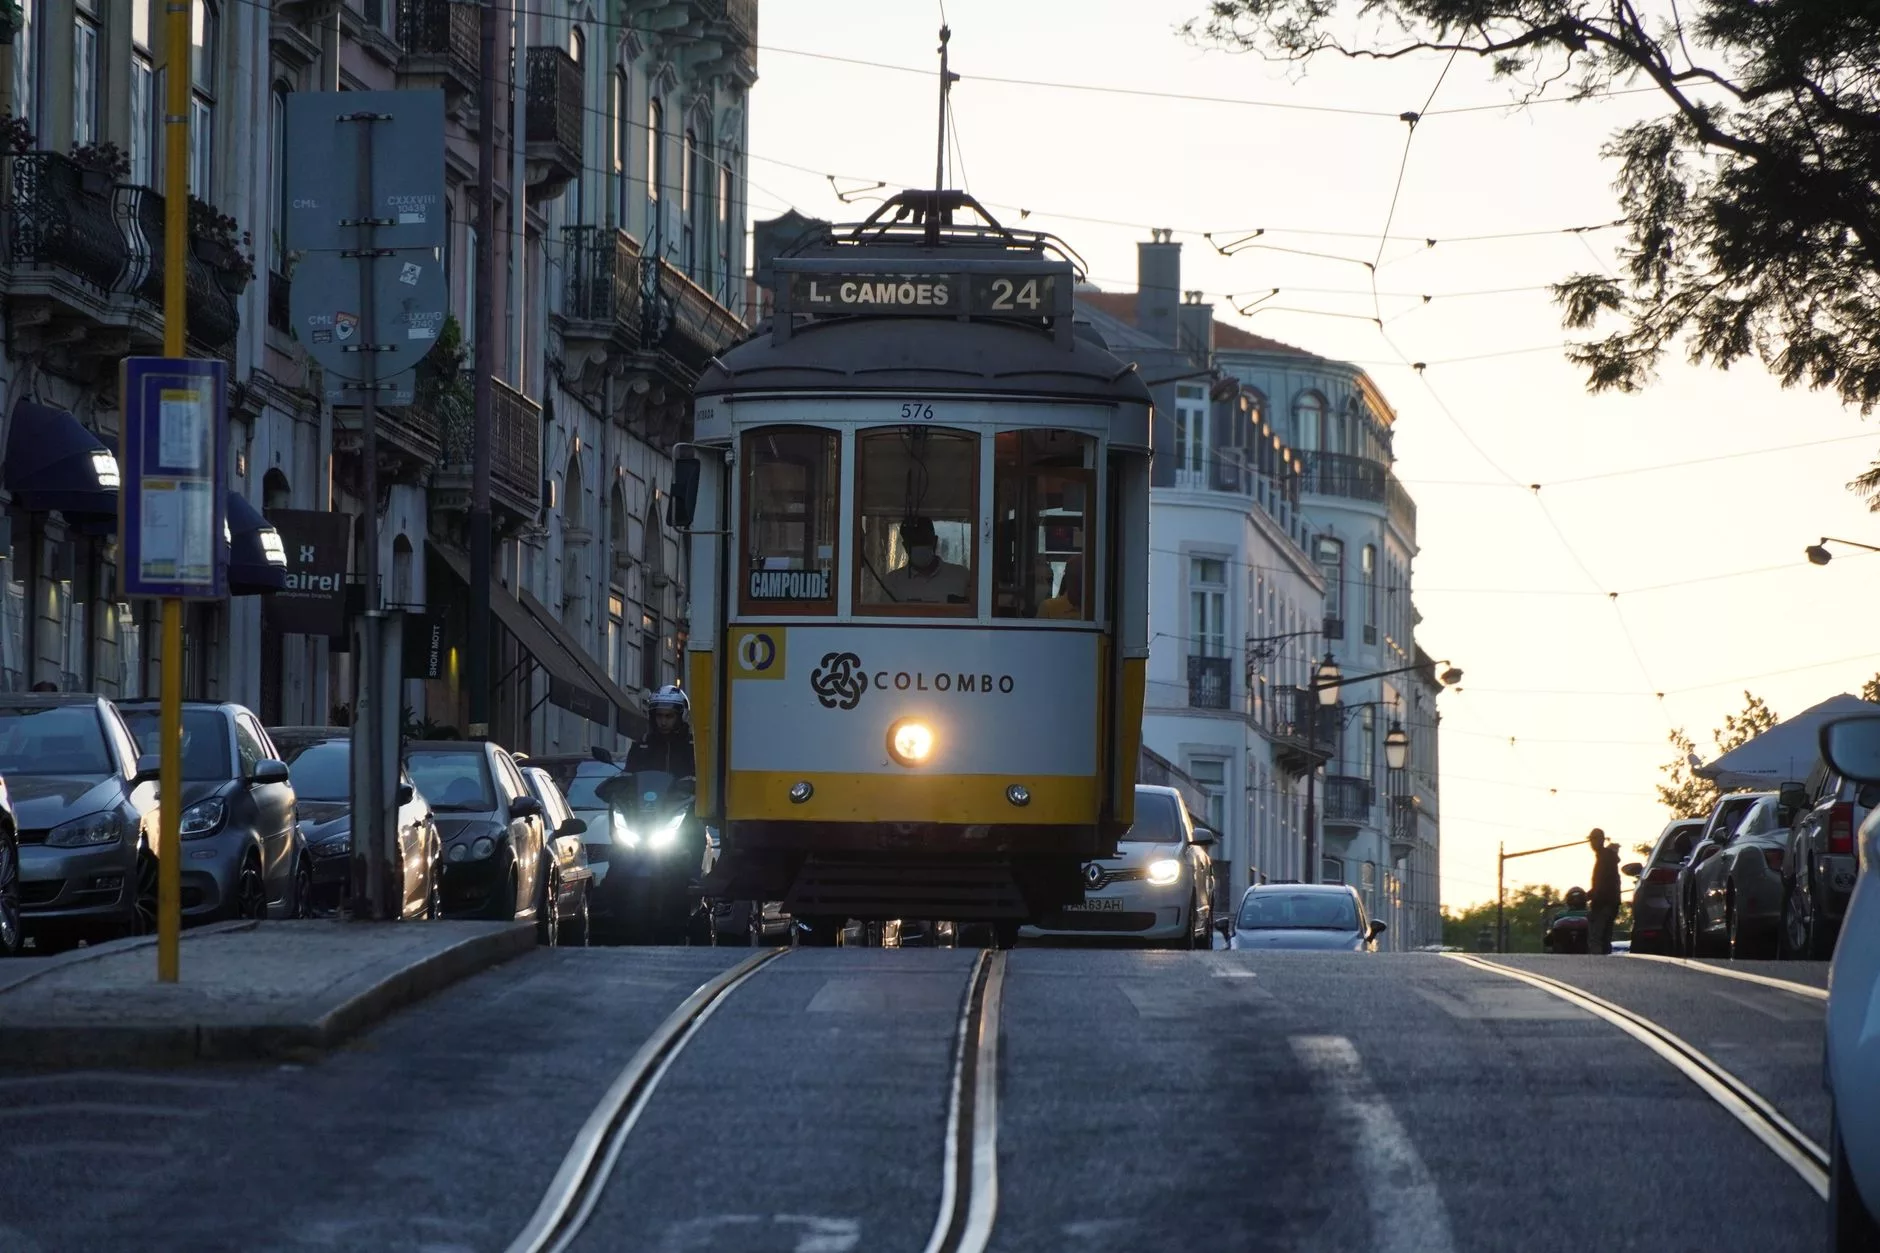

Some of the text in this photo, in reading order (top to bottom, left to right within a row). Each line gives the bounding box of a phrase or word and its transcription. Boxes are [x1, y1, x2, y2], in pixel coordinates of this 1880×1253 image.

[810, 281, 831, 302] L.
[991, 279, 1040, 310] 24
[308, 315, 333, 326] CML
[901, 403, 934, 420] 576
[285, 571, 341, 592] airel
[751, 571, 829, 599] CAMPOLIDE
[429, 624, 441, 676] SHON MOTT
[874, 671, 1014, 693] COLOMBO
